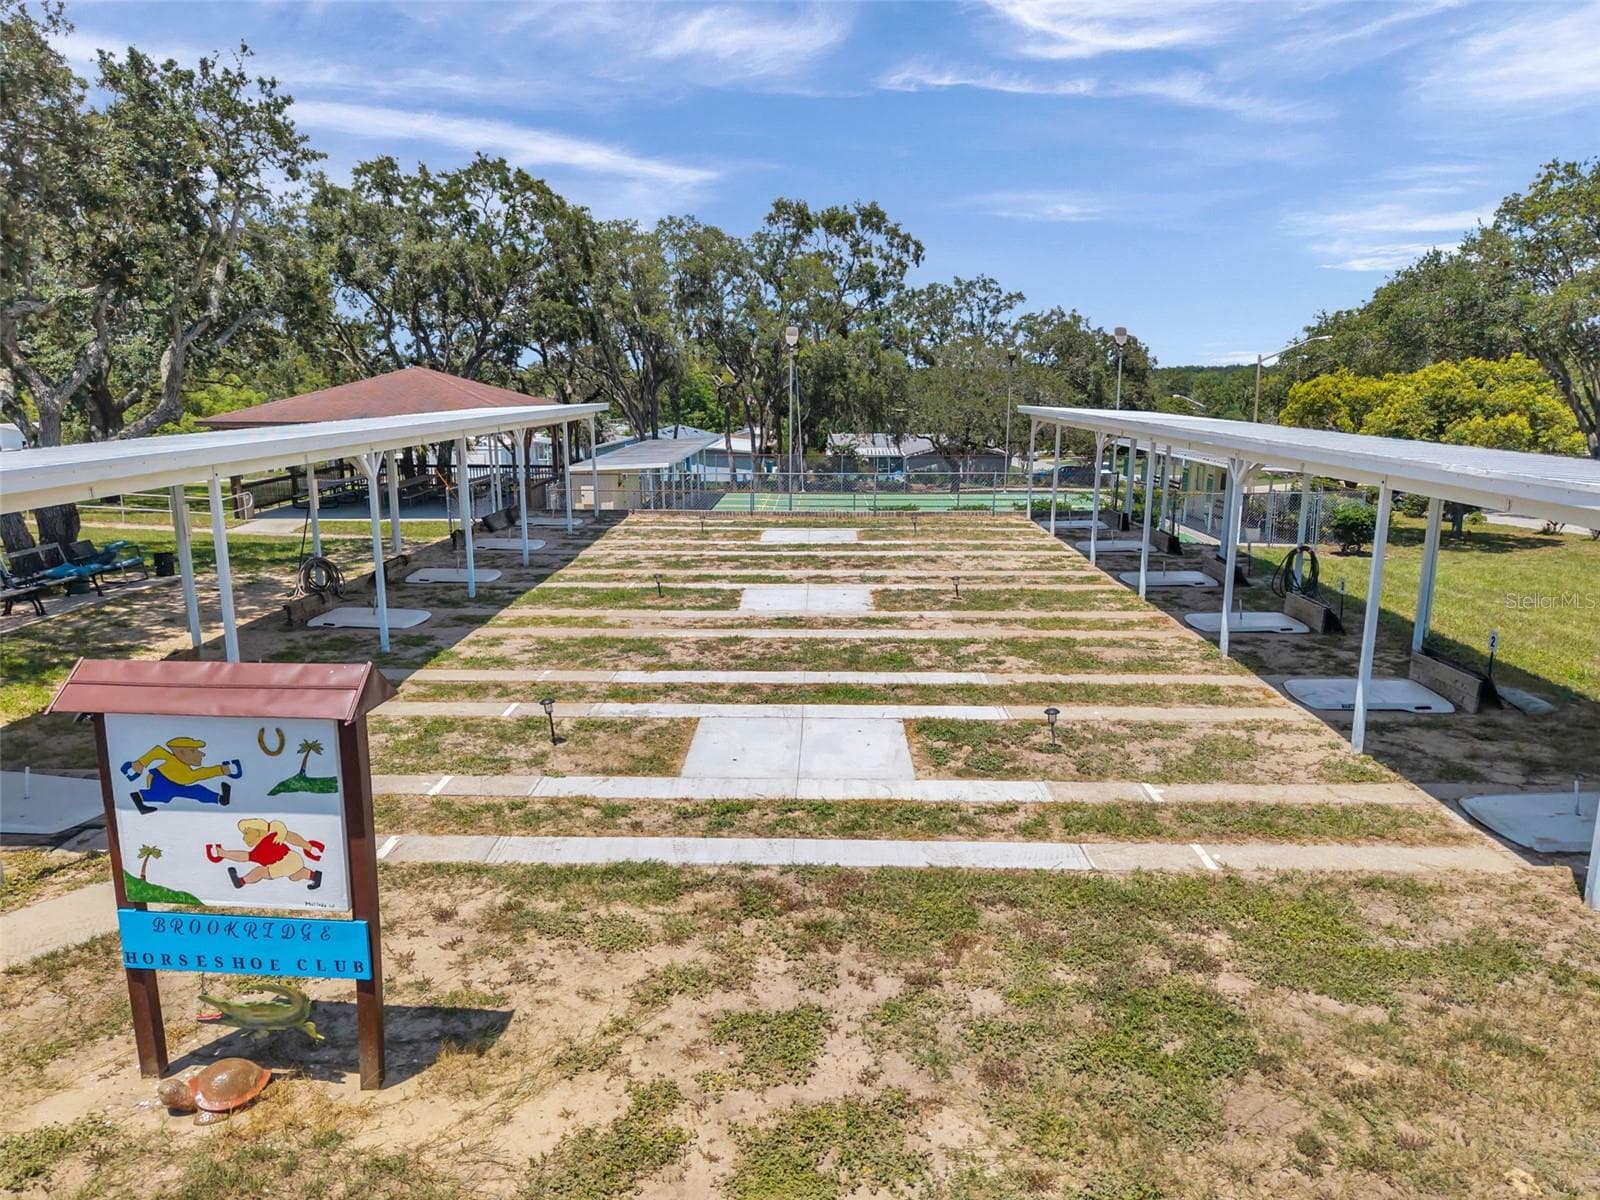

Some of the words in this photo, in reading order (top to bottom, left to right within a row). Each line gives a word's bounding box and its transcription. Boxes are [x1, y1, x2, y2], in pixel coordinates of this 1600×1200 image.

[1490, 635, 1496, 648] 2
[152, 917, 332, 941] BROOKRIDGE
[125, 952, 280, 970] HORSESHOE
[297, 959, 364, 973] CLUB
